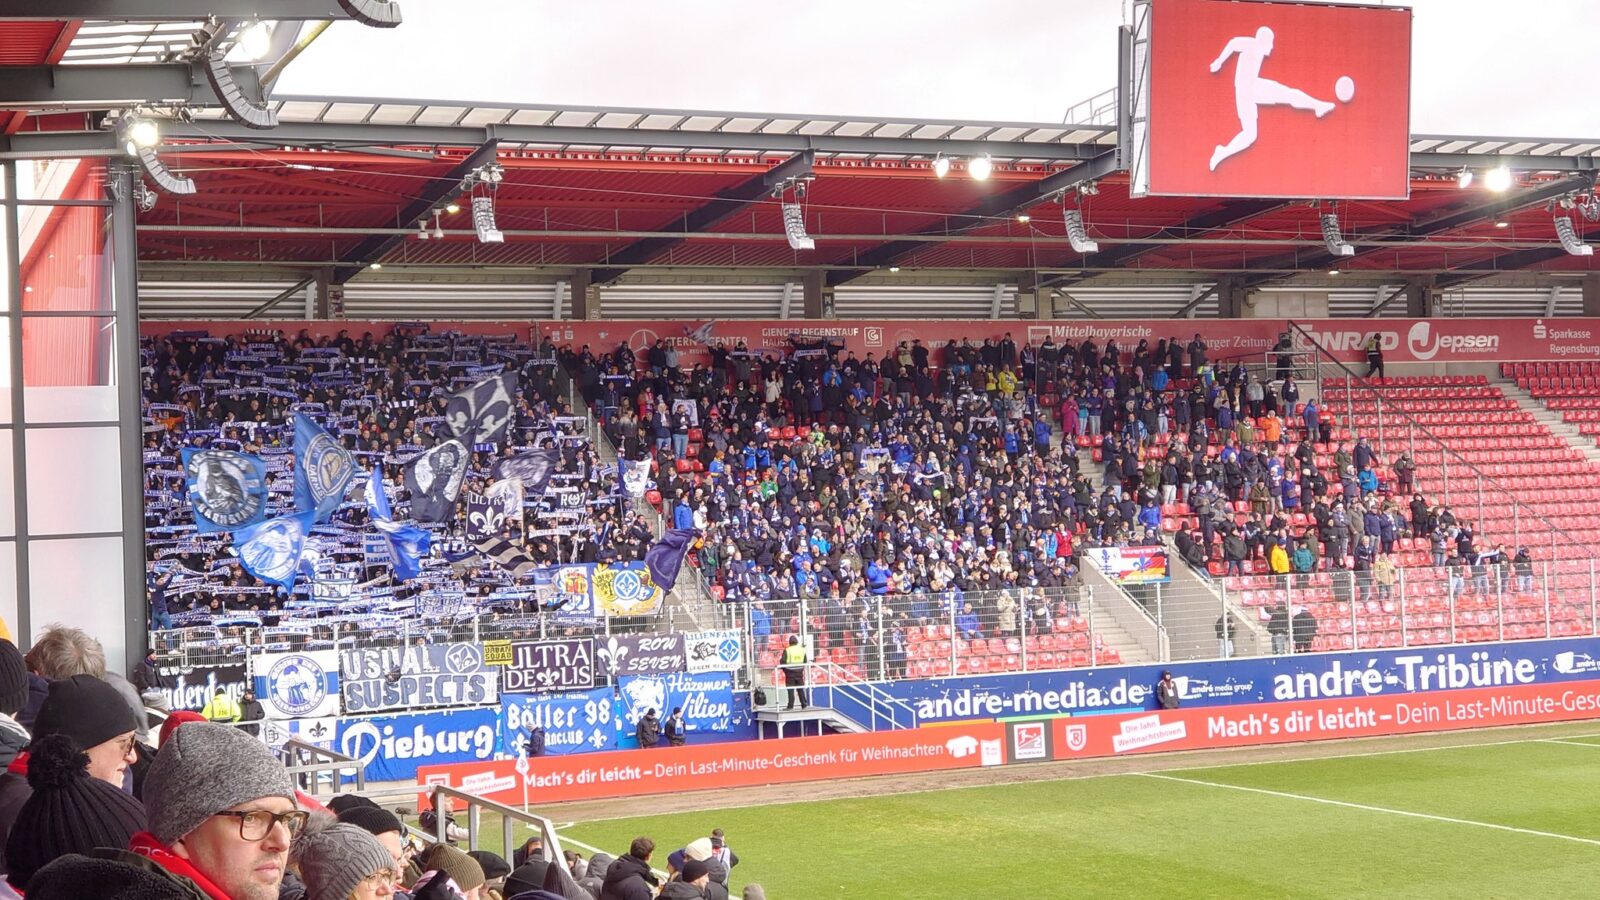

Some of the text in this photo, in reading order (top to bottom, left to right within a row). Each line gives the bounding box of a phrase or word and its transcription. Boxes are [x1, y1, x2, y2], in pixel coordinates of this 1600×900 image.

[802, 328, 859, 337] REGENSTAUF
[1055, 325, 1152, 340] Mittelbayerische
[1233, 336, 1274, 350] Zeitung
[1549, 329, 1591, 340] Sparkasse
[1550, 344, 1600, 356] Regensburg
[638, 637, 678, 652] ROW
[506, 643, 590, 670] ULTRA
[627, 654, 681, 672] SEVEN
[506, 665, 591, 688] DE LIS
[1272, 653, 1537, 700] andré-Tribüne
[346, 674, 486, 711] SUSPECTS
[918, 678, 1146, 720] andre-media.de
[507, 697, 611, 730] Böller 98
[1285, 706, 1313, 734] dir
[1318, 701, 1377, 731] leicht
[1395, 701, 1440, 726] Dein
[341, 719, 495, 777] Dieburg
[545, 729, 584, 746] ANCLUB
[576, 768, 597, 786] dir
[600, 763, 641, 783] leicht
[655, 760, 687, 779] Dein
[690, 749, 837, 776] Last-Minute-Geschenk
[839, 747, 858, 763] für
[861, 742, 944, 761] Weihnachten
